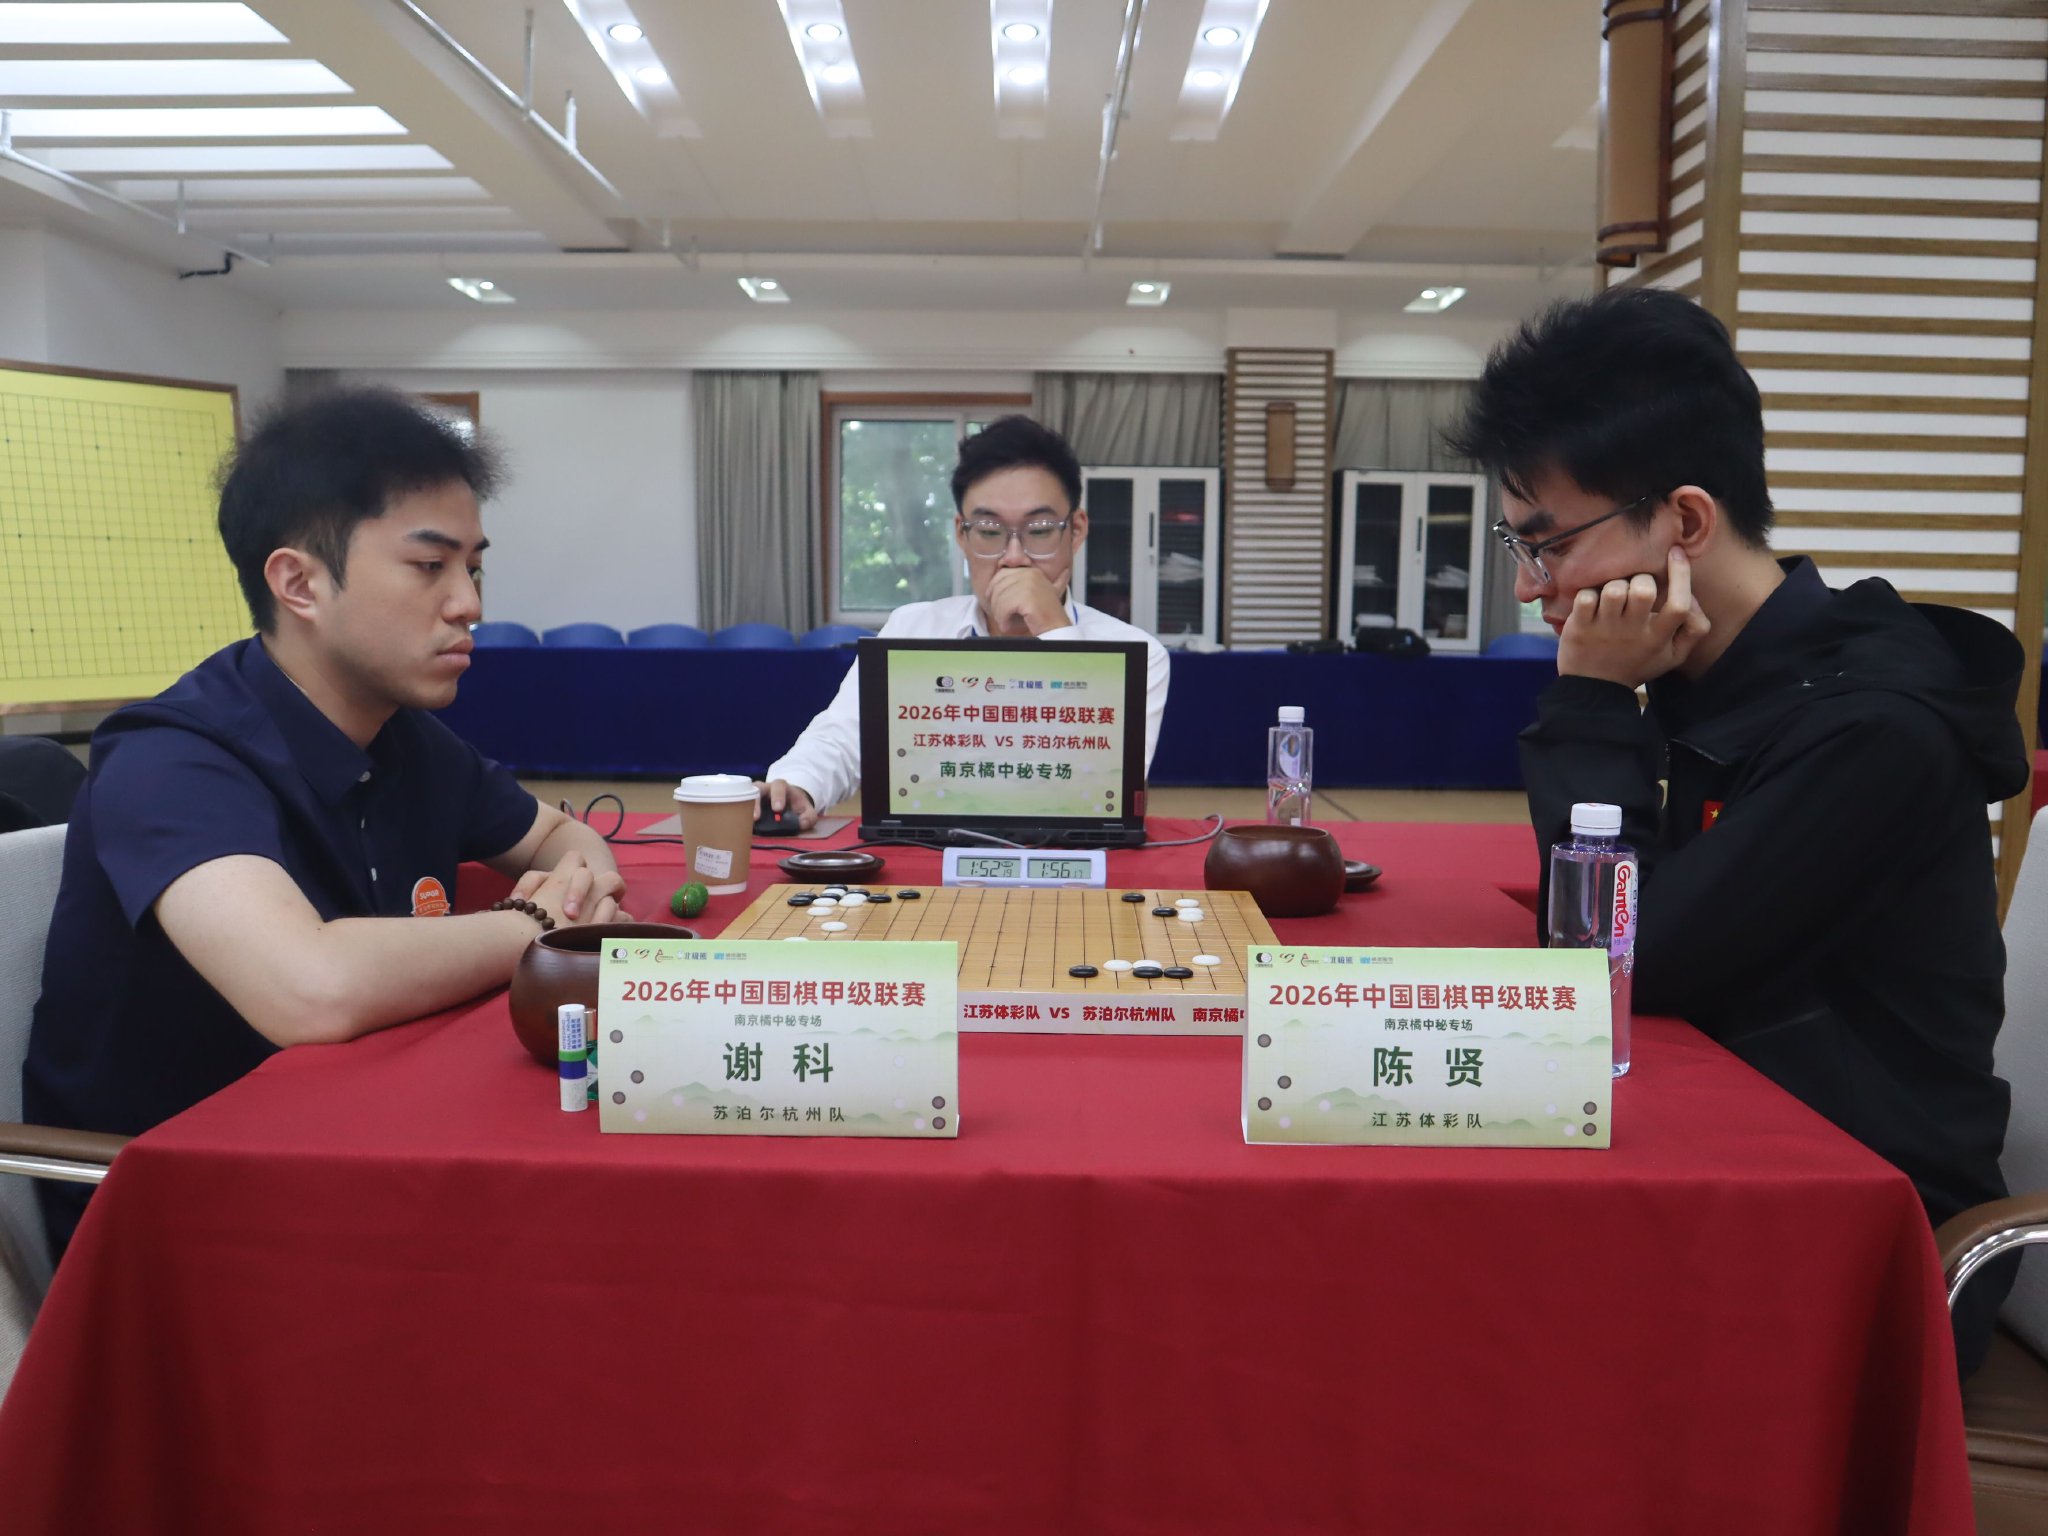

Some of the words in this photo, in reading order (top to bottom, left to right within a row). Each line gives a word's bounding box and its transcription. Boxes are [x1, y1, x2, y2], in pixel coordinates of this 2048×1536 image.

[898, 704, 1115, 725] 2026年中国围棋甲级联赛
[913, 733, 986, 748] 江苏体彩队
[995, 736, 1014, 748] VS
[1022, 734, 1111, 750] 苏泊尔杭州队
[939, 760, 1073, 780] 南京橘中秘专场
[970, 861, 1000, 877] 1:52
[1041, 862, 1070, 879] 1:56
[622, 979, 926, 1007] 2026年中国围棋甲级联赛
[1269, 983, 1577, 1011] 2026年中国围棋甲级联赛
[734, 1013, 823, 1028] 南京橘中秘专场
[963, 1003, 1042, 1021] 江苏体彩队
[1048, 1007, 1071, 1020] VS
[1082, 1005, 1177, 1023] 苏泊尔杭州队
[1384, 1017, 1473, 1032] 南京橘中秘专场
[712, 1105, 846, 1123] 苏泊尔杭州队
[1371, 1112, 1484, 1130] 江苏体彩队
